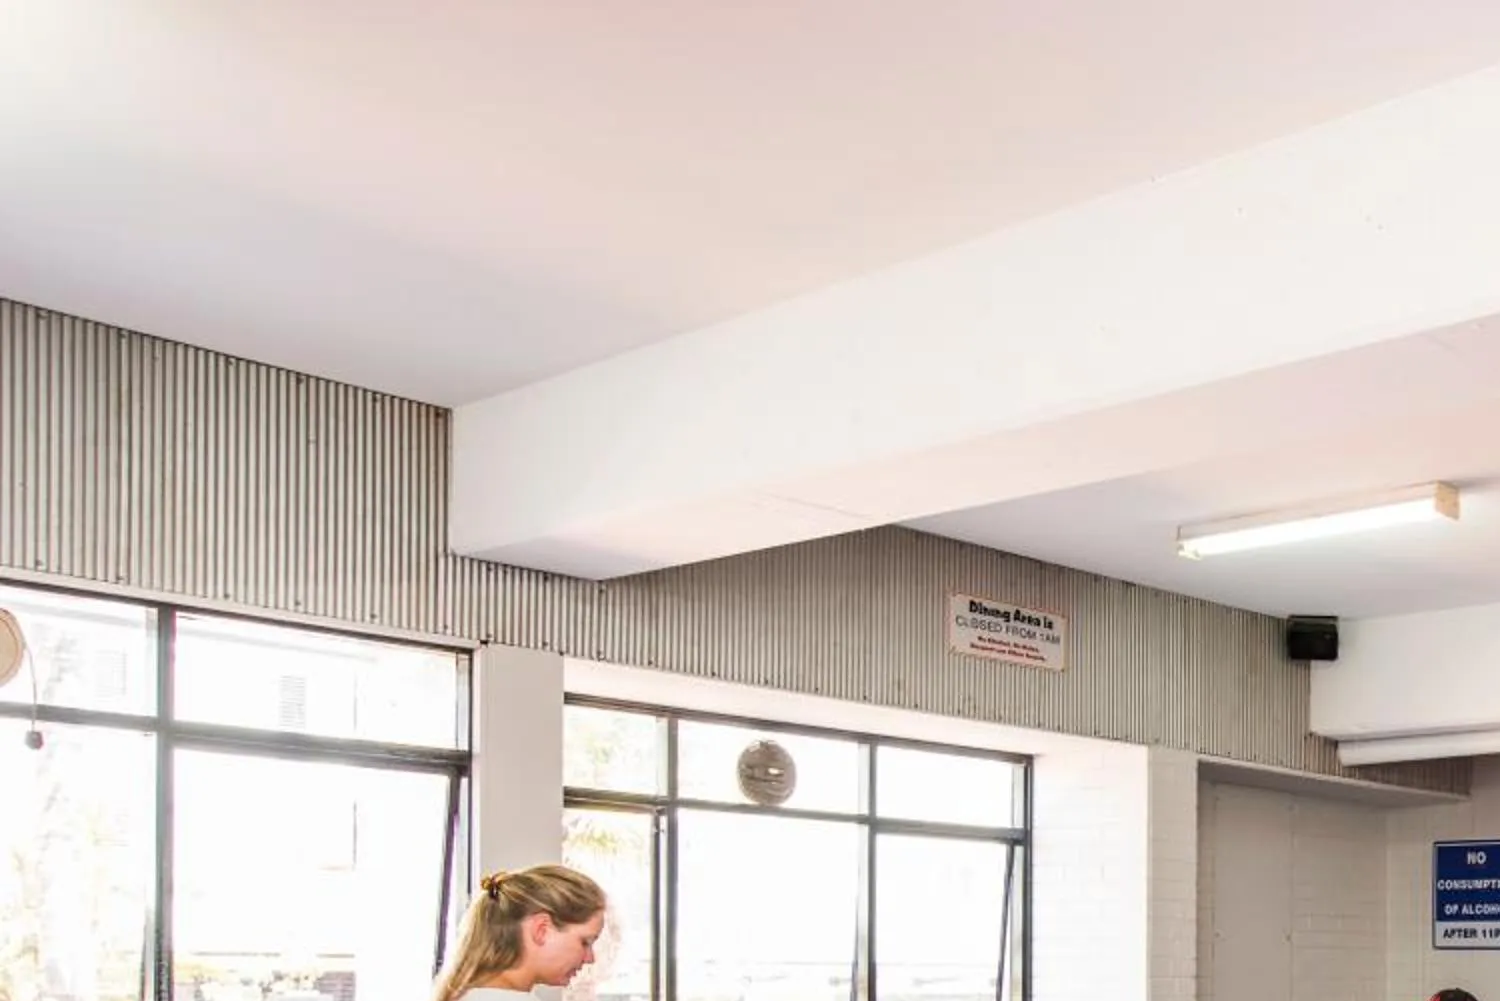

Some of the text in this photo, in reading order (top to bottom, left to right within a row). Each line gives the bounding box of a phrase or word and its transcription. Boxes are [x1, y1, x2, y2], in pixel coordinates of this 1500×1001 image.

[969, 600, 1010, 622] Dining
[1013, 609, 1041, 627] Area
[955, 614, 1003, 633] CLOSED
[1005, 624, 1037, 640] FROM
[1467, 851, 1487, 865] NO
[1444, 904, 1459, 915] OF
[1443, 927, 1478, 939] AFTER
